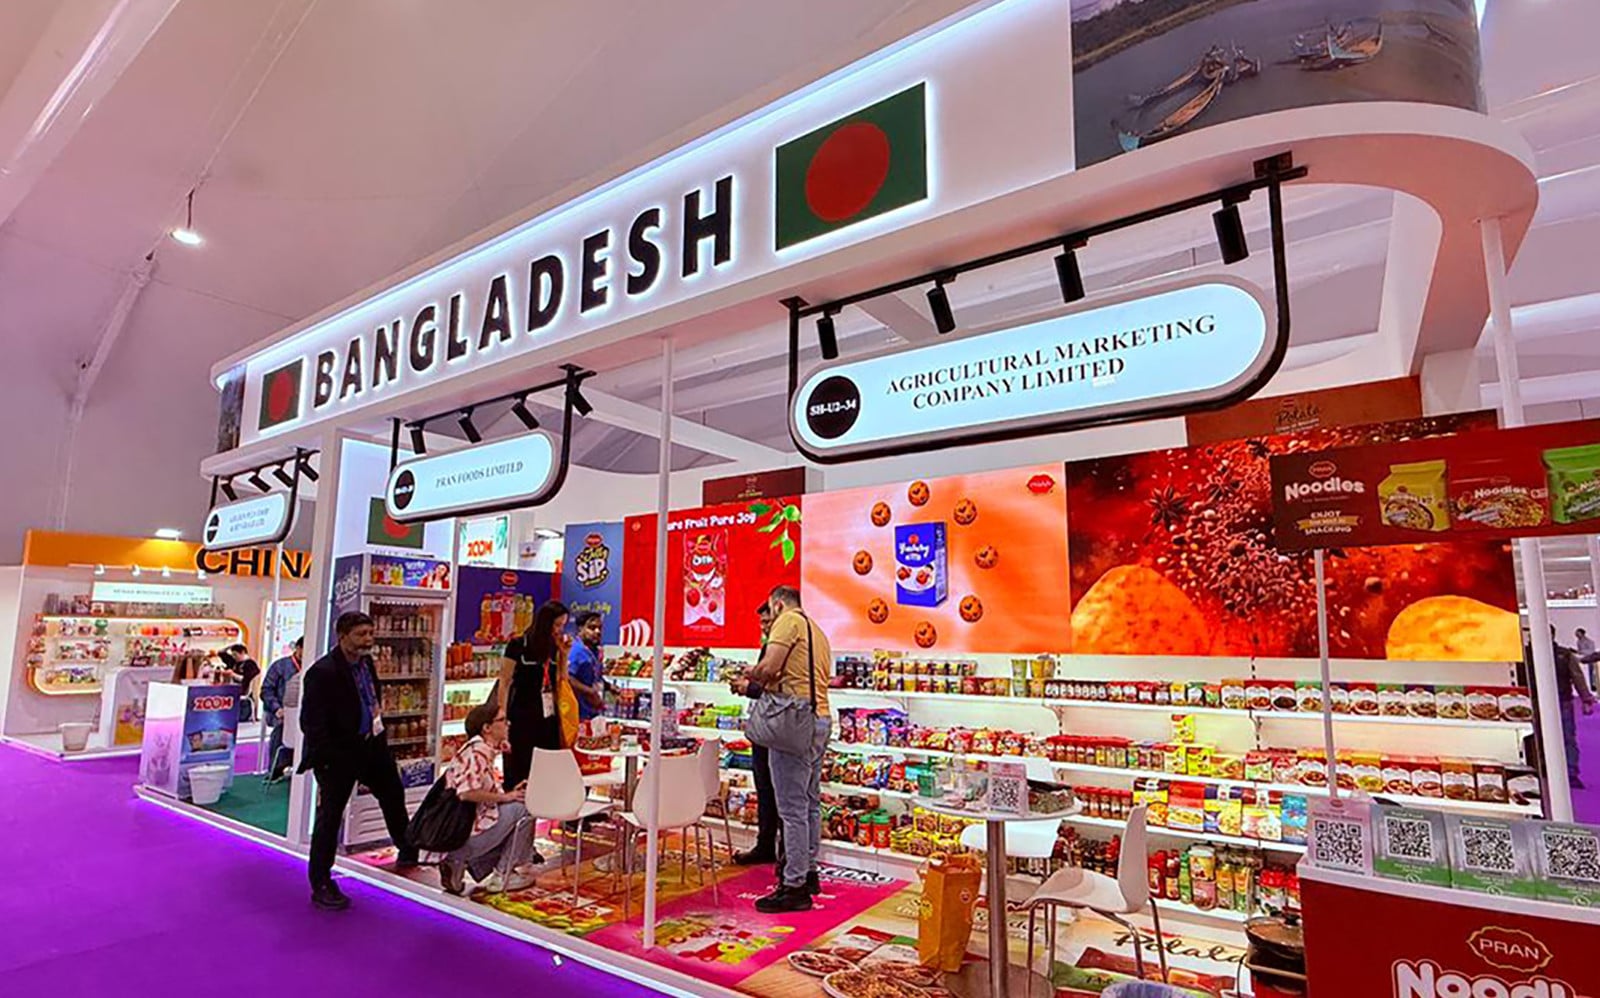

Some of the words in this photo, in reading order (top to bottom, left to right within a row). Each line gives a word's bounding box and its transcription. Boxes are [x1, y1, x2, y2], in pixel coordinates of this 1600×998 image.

[313, 174, 734, 409] BANGLADESH
[885, 349, 1050, 396] AGRICULTURAL
[1053, 314, 1217, 362] MARKETING
[912, 376, 1015, 410] COMPANY
[1021, 356, 1126, 392] LIMITED
[458, 468, 485, 484] FOODS
[485, 460, 524, 479] LIMITED
[1284, 476, 1365, 502] Noodles
[1474, 485, 1529, 499] Noodles
[685, 516, 708, 530] Fruit
[710, 514, 735, 527] Pure
[737, 511, 757, 524] Joy
[1310, 510, 1341, 518] ENJOY
[467, 540, 494, 557] ZOOM
[193, 695, 234, 711] ZOOM
[1479, 938, 1540, 960] PRAN
